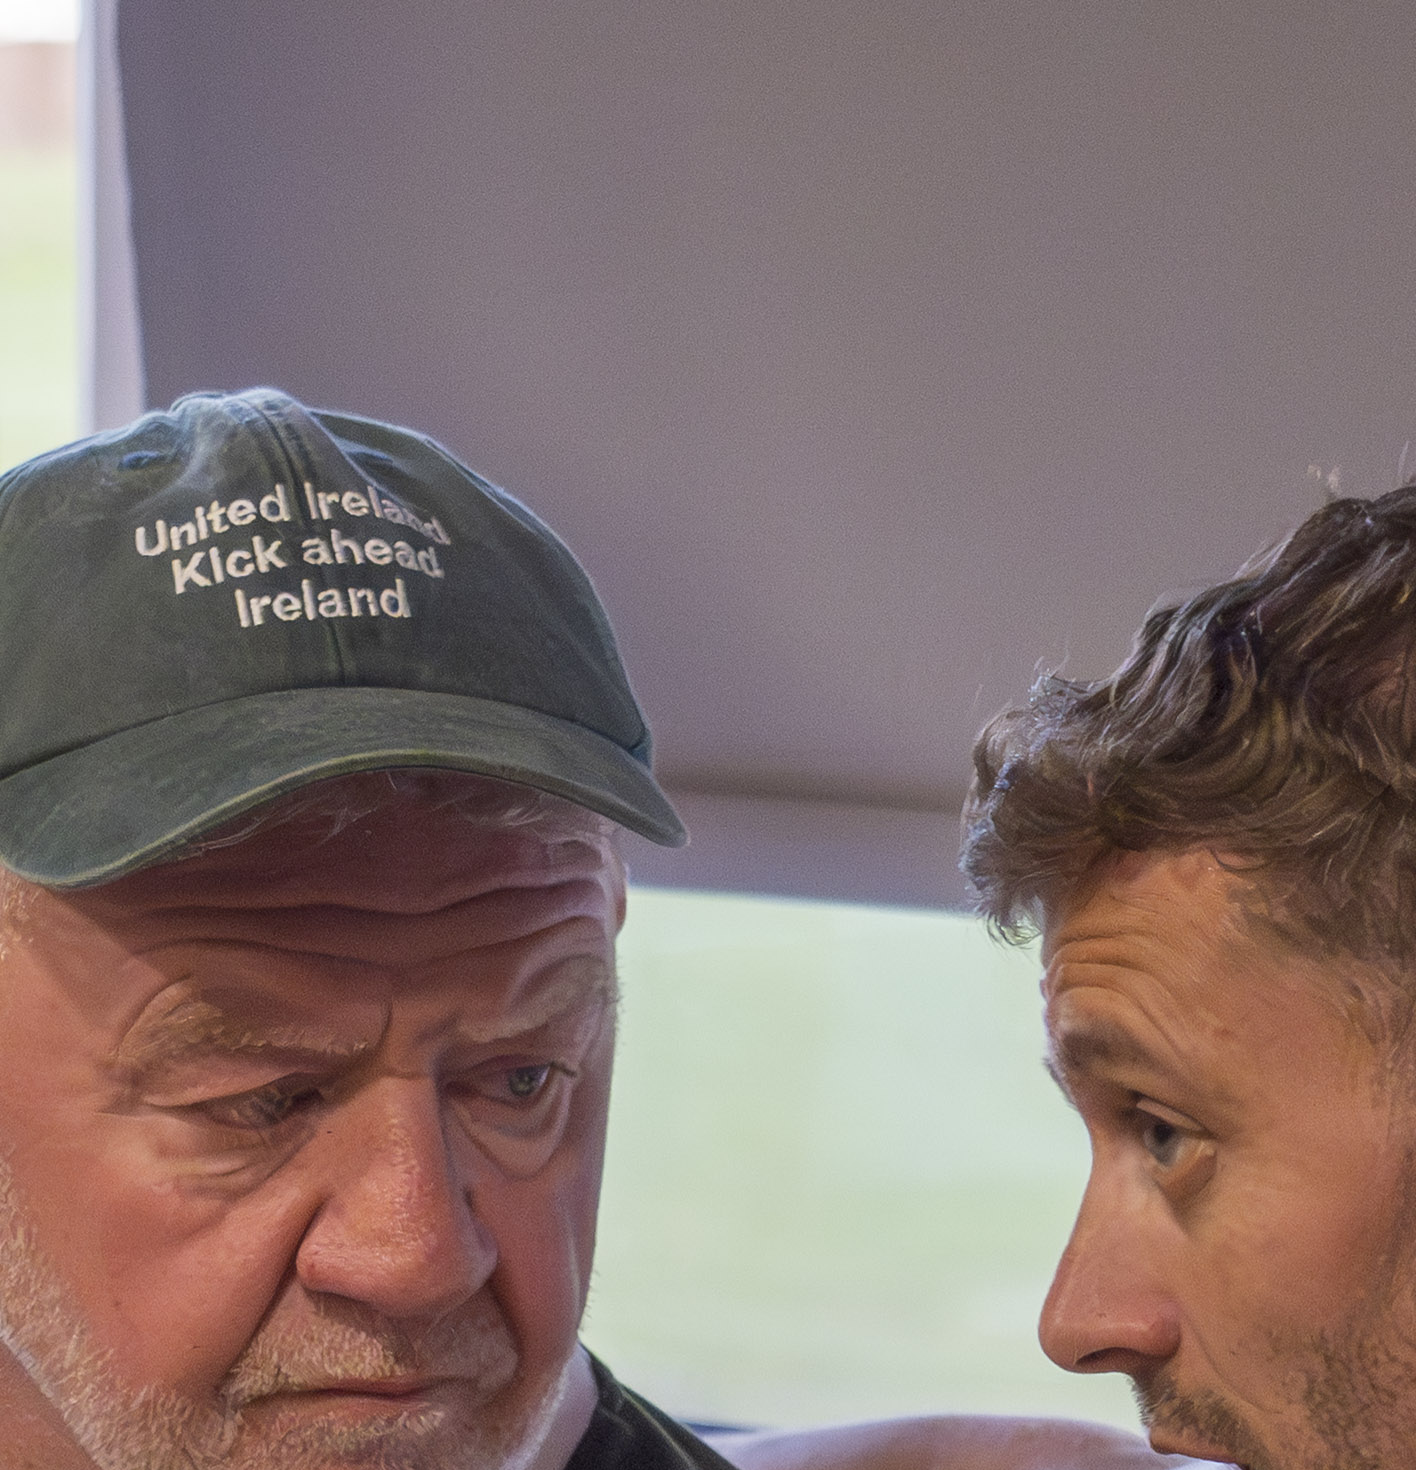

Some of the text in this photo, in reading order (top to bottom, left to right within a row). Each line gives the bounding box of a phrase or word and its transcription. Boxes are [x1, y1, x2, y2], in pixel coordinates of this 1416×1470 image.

[135, 482, 451, 556] United Ireland
[302, 528, 444, 578] ahead
[235, 578, 411, 628] Ireland
